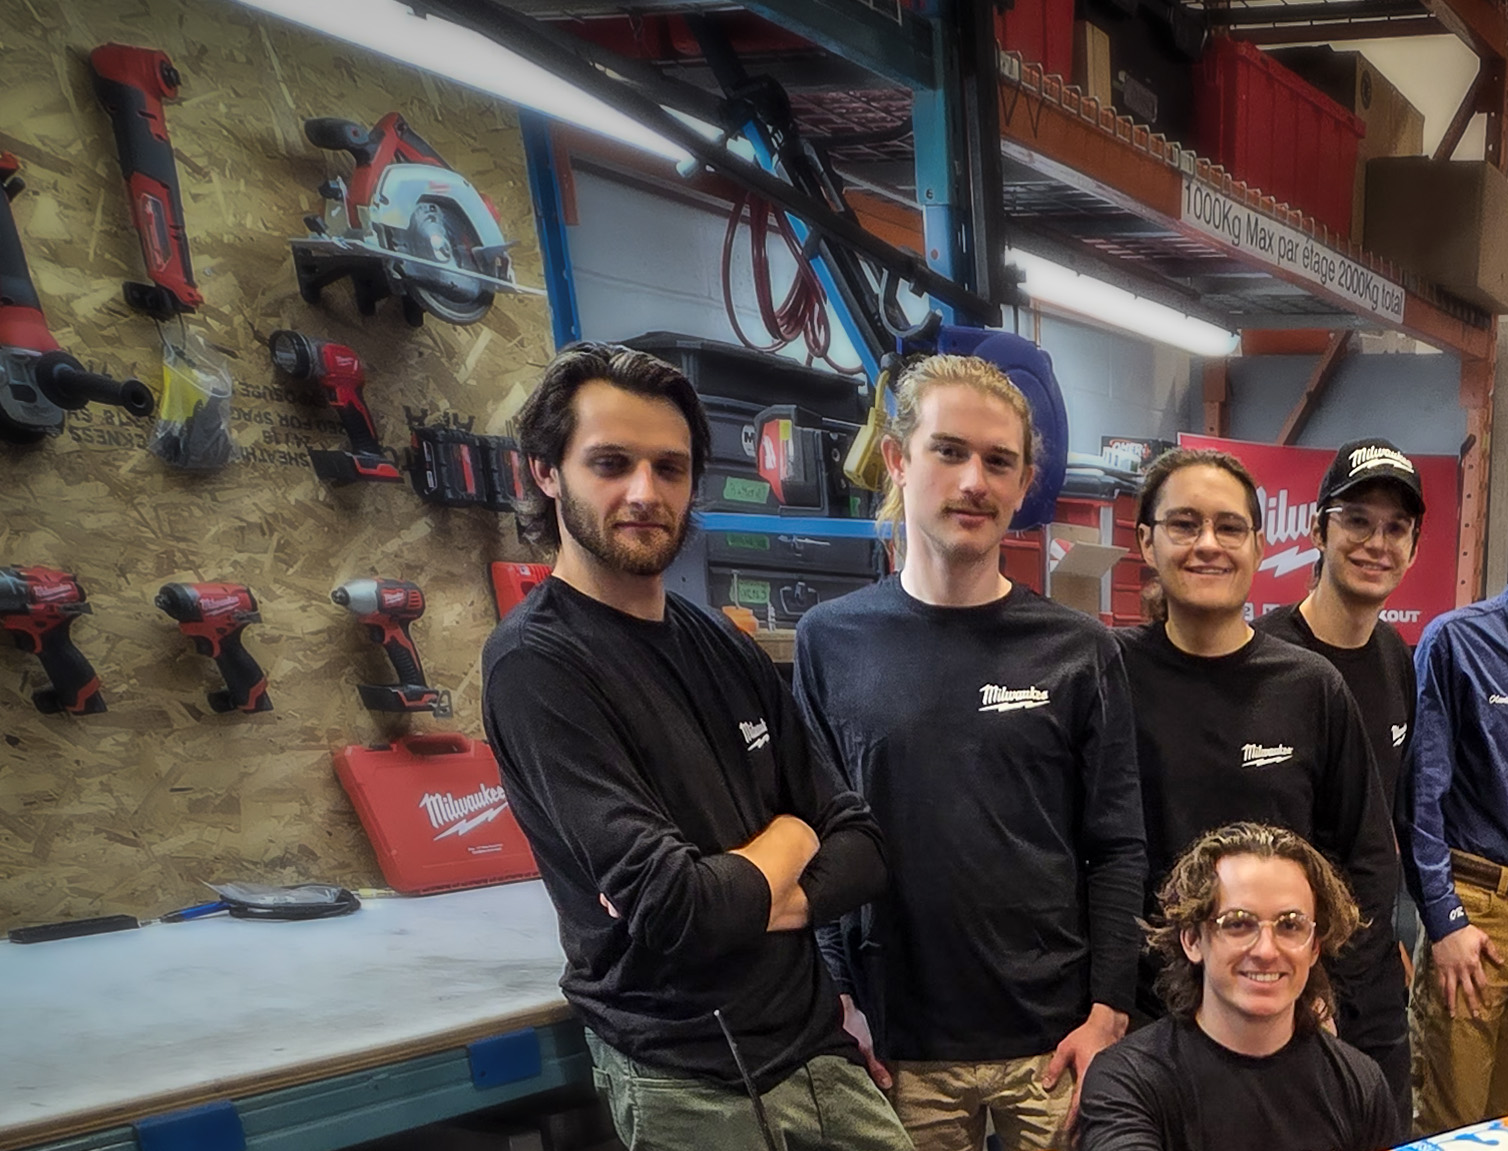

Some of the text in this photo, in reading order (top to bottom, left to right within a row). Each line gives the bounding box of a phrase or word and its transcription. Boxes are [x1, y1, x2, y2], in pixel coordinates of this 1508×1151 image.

[1185, 180, 1404, 316] 1000Kg Max par étage 2000Kg total
[979, 683, 1049, 705] Milwaukee
[419, 783, 505, 829] Milwaukee
